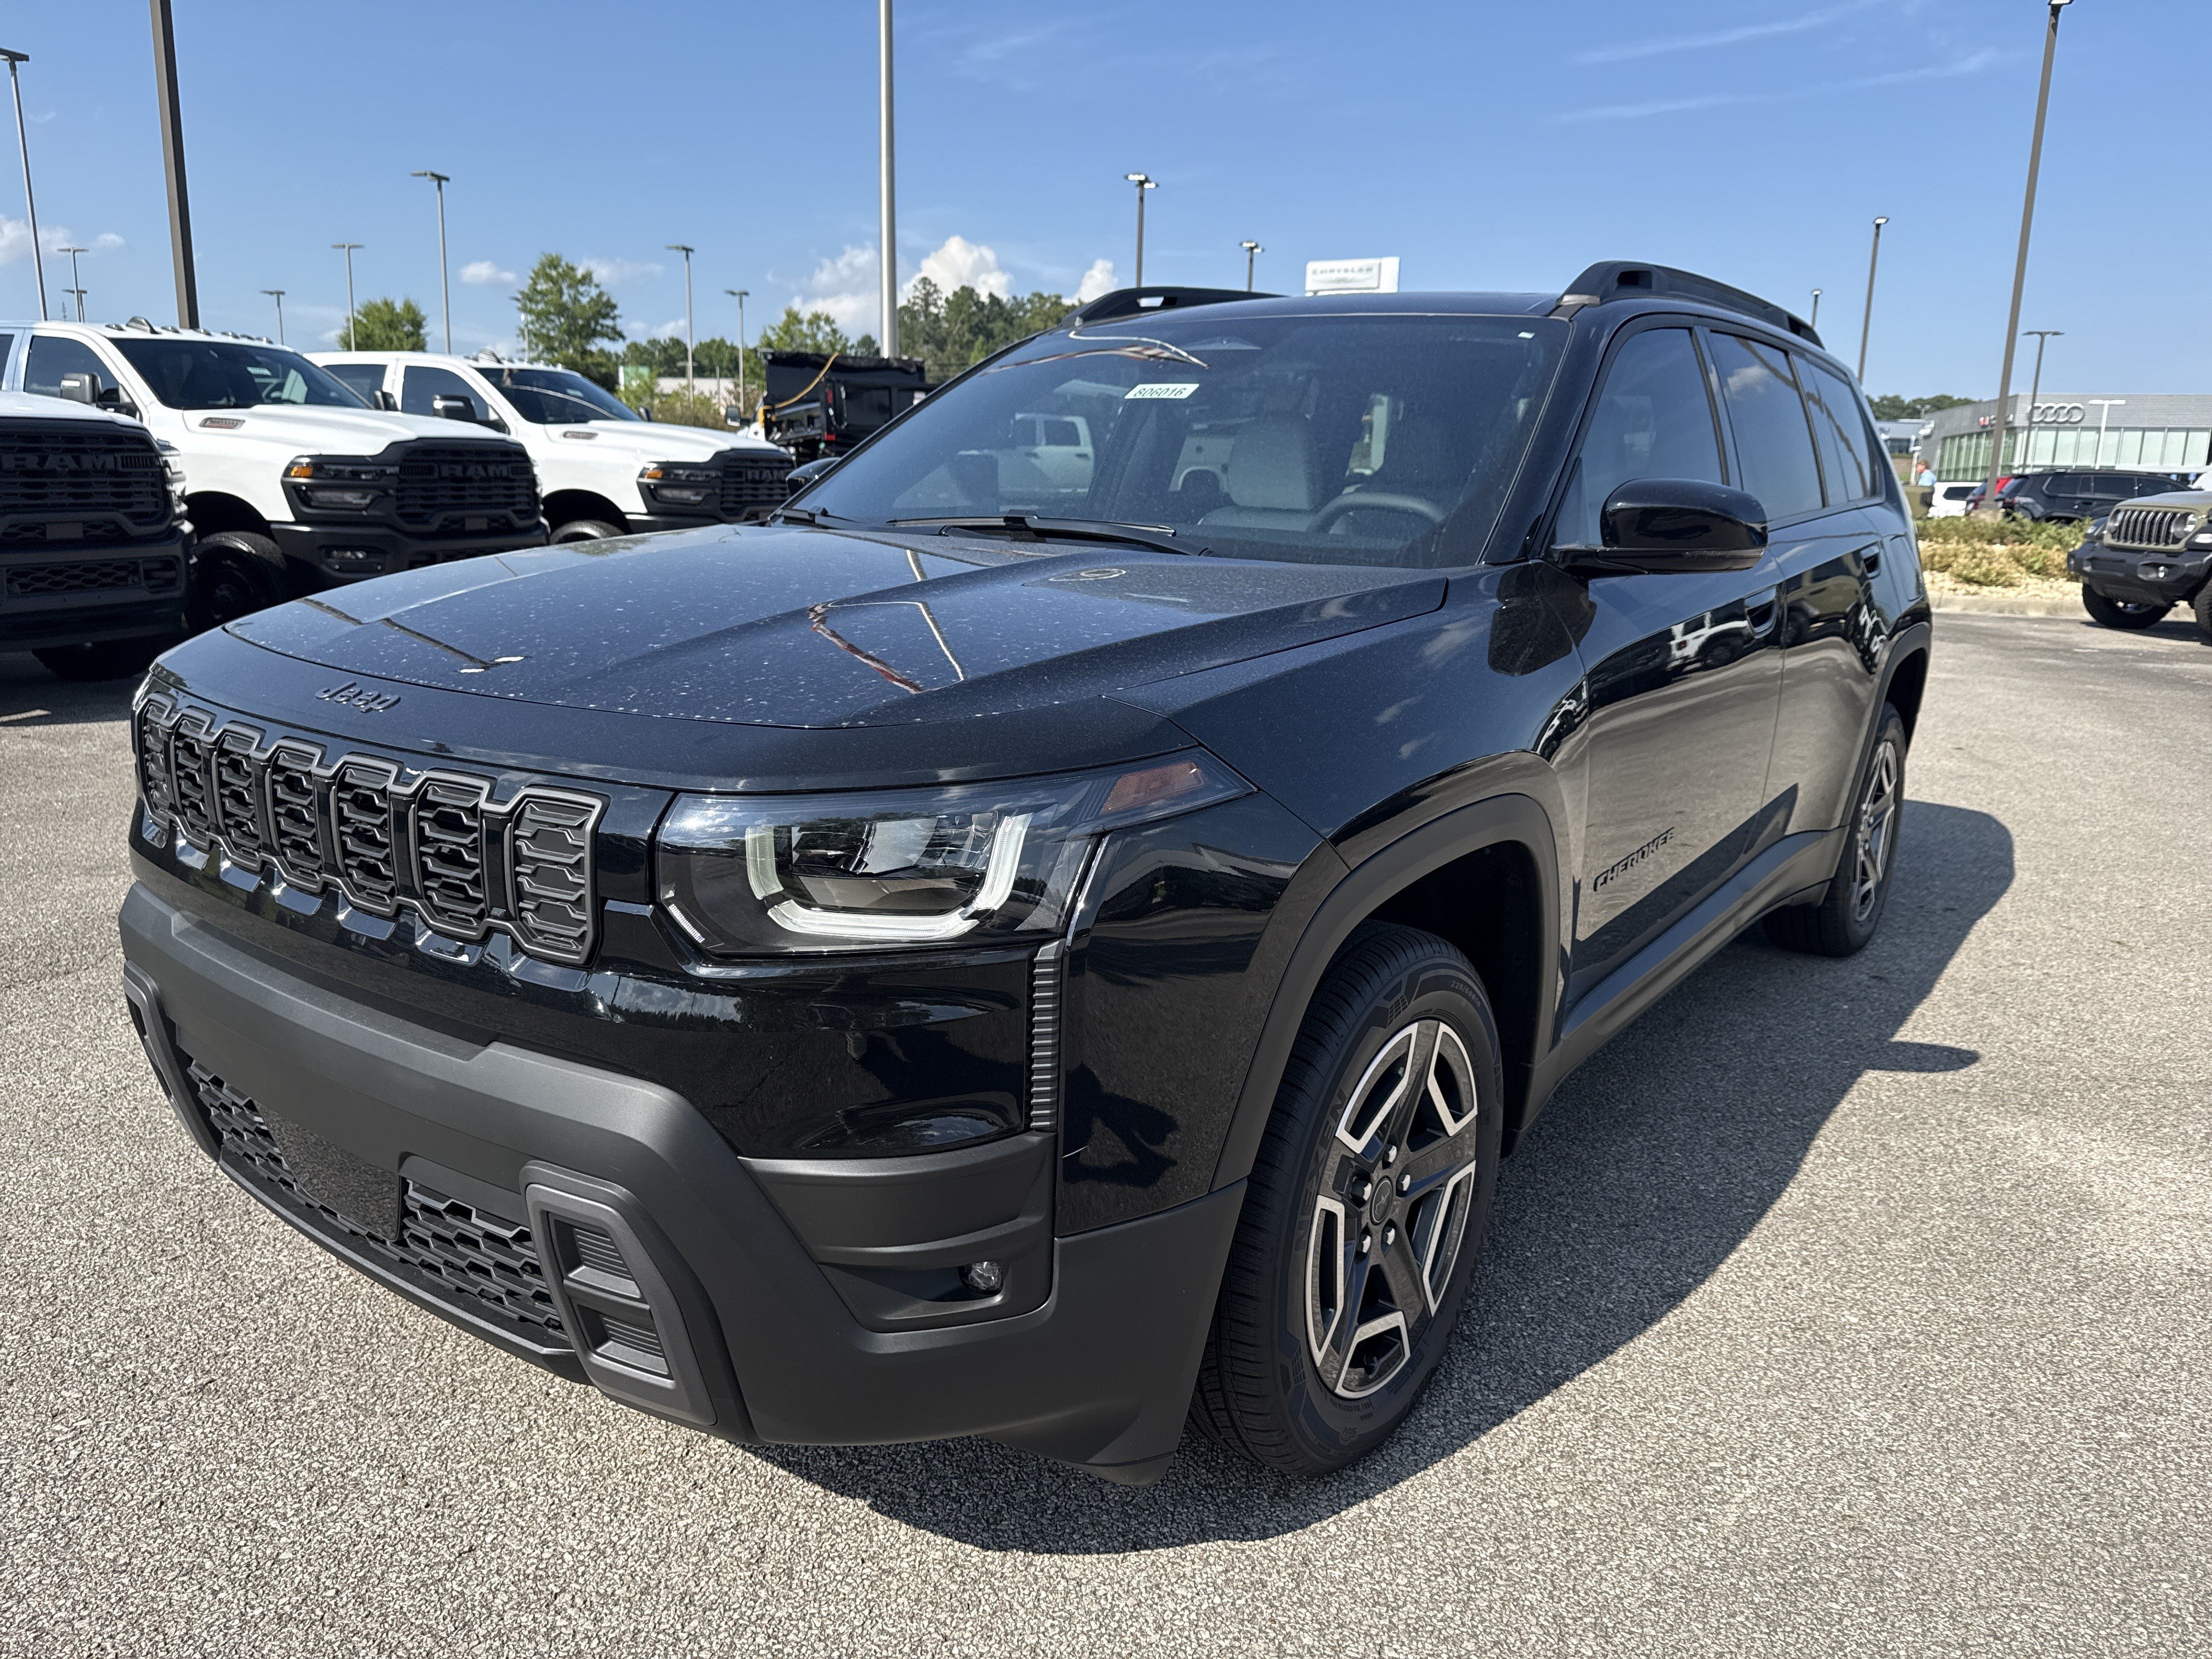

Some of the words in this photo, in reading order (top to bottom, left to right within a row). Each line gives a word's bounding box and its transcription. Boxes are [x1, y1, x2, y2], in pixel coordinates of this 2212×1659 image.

[1133, 387, 1187, 397] 806016
[2, 453, 114, 471] RAM
[441, 465, 509, 478] RAM
[315, 681, 402, 713] Jeep
[1593, 827, 1674, 892] CHEROKEE
[1294, 1088, 1347, 1251] NEXEN
